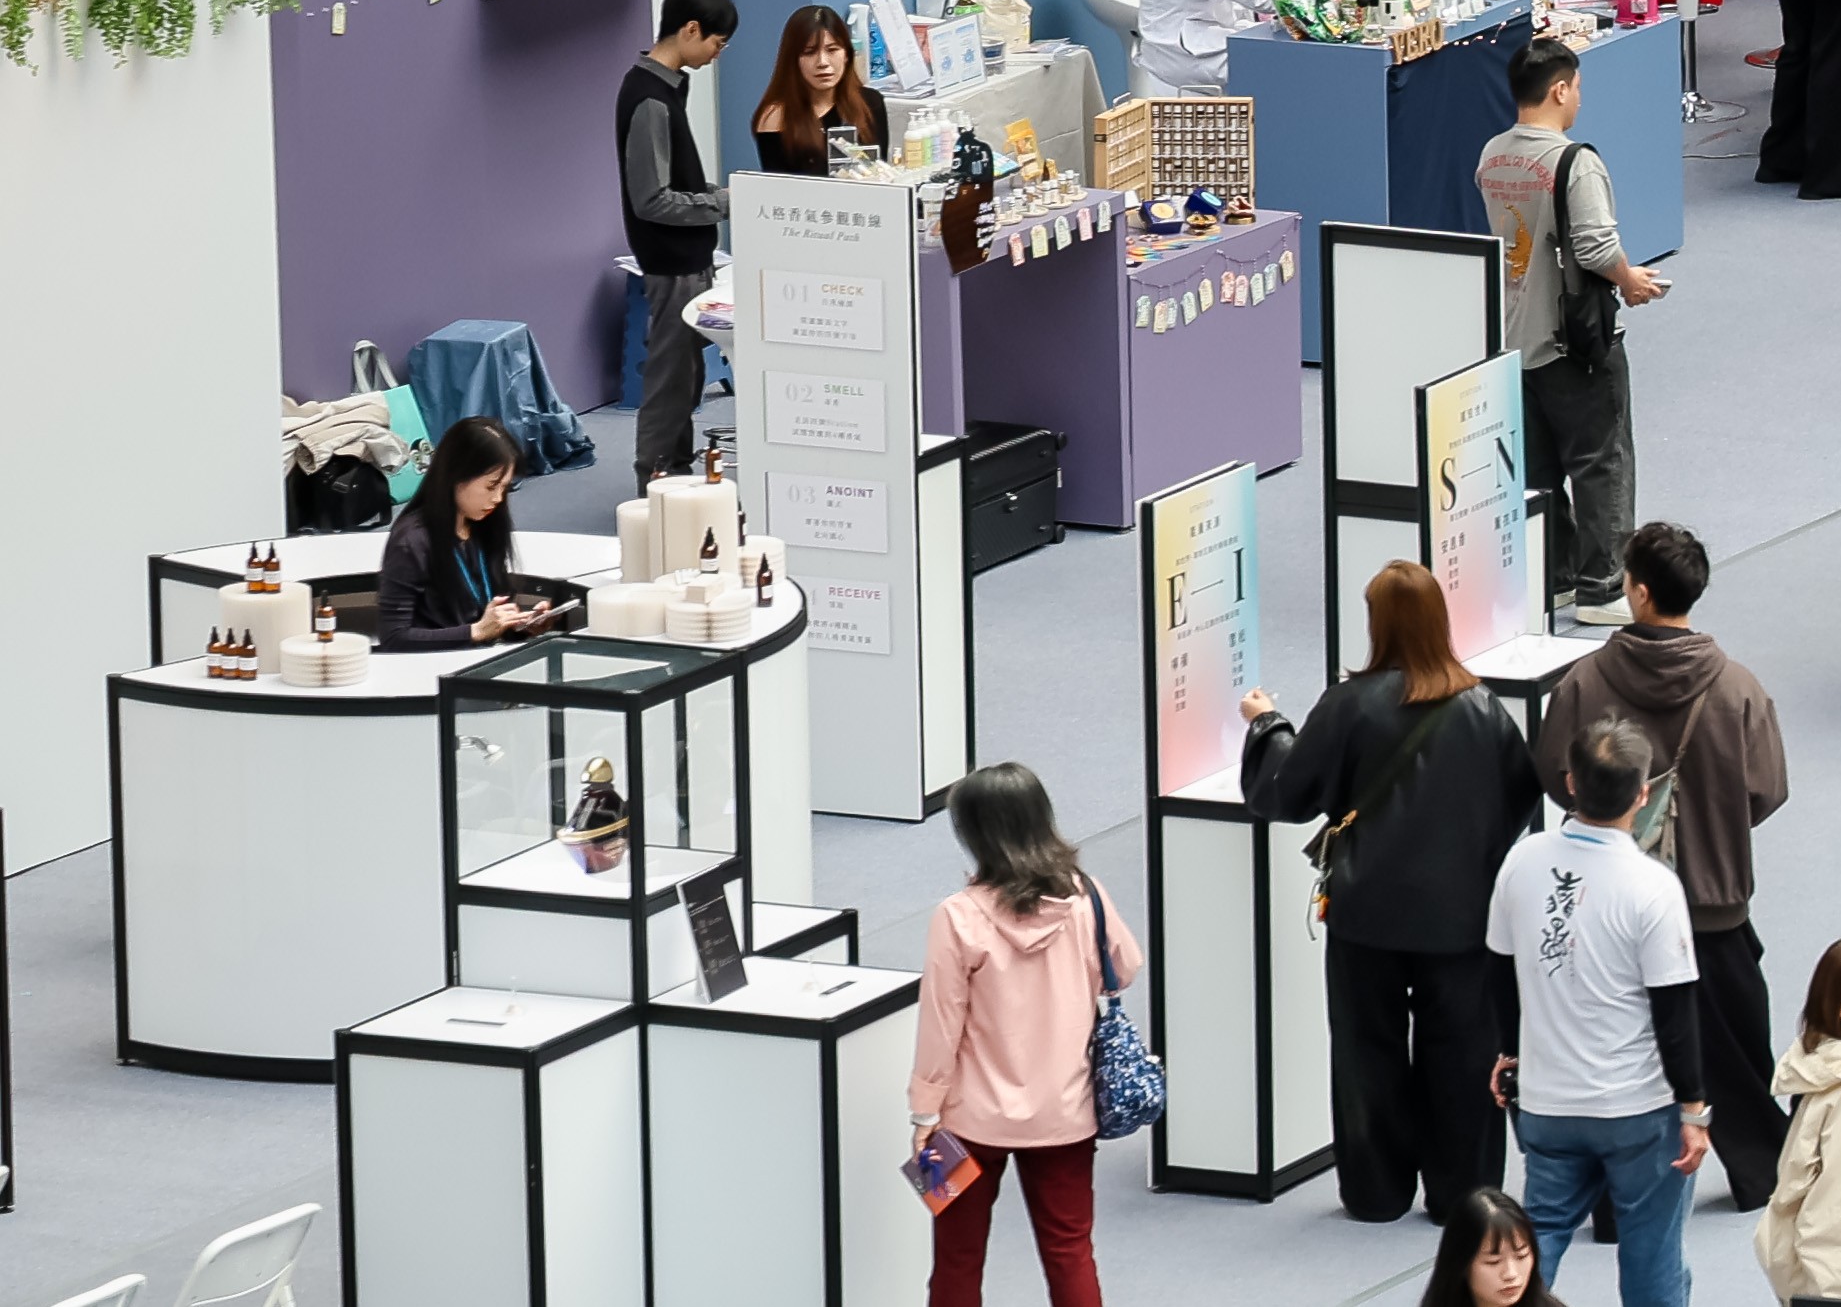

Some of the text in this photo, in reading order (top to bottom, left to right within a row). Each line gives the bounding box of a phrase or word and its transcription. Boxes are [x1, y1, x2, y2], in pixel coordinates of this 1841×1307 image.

[1391, 18, 1445, 65] VERO
[821, 283, 865, 296] CHECK
[823, 383, 865, 397] SMELL
[825, 485, 874, 499] ANOINT
[828, 586, 882, 601] RECEIVE
